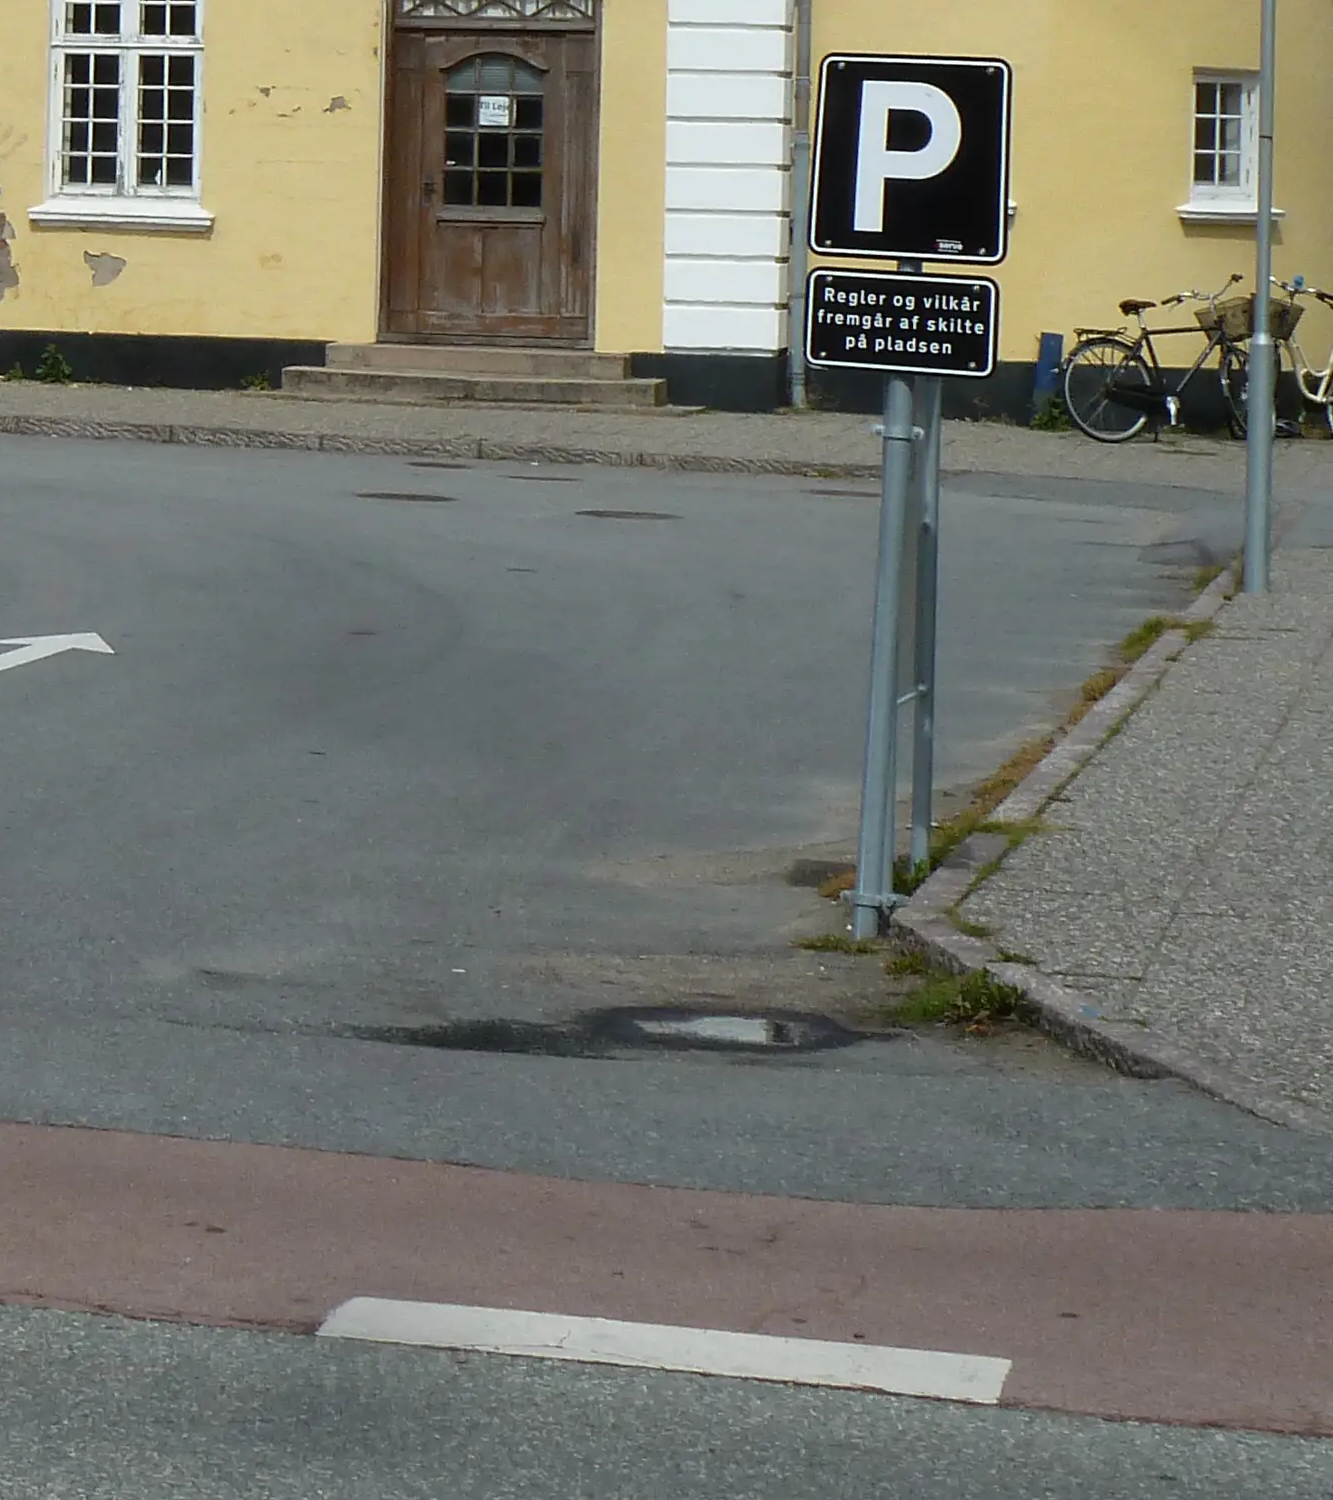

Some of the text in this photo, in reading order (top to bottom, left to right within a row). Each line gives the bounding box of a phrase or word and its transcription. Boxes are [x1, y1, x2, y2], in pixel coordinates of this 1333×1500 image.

[853, 80, 962, 233] P
[824, 287, 980, 312] Regler og vilkår
[817, 309, 984, 334] fremgår af skilte
[846, 334, 952, 354] på pladsen
